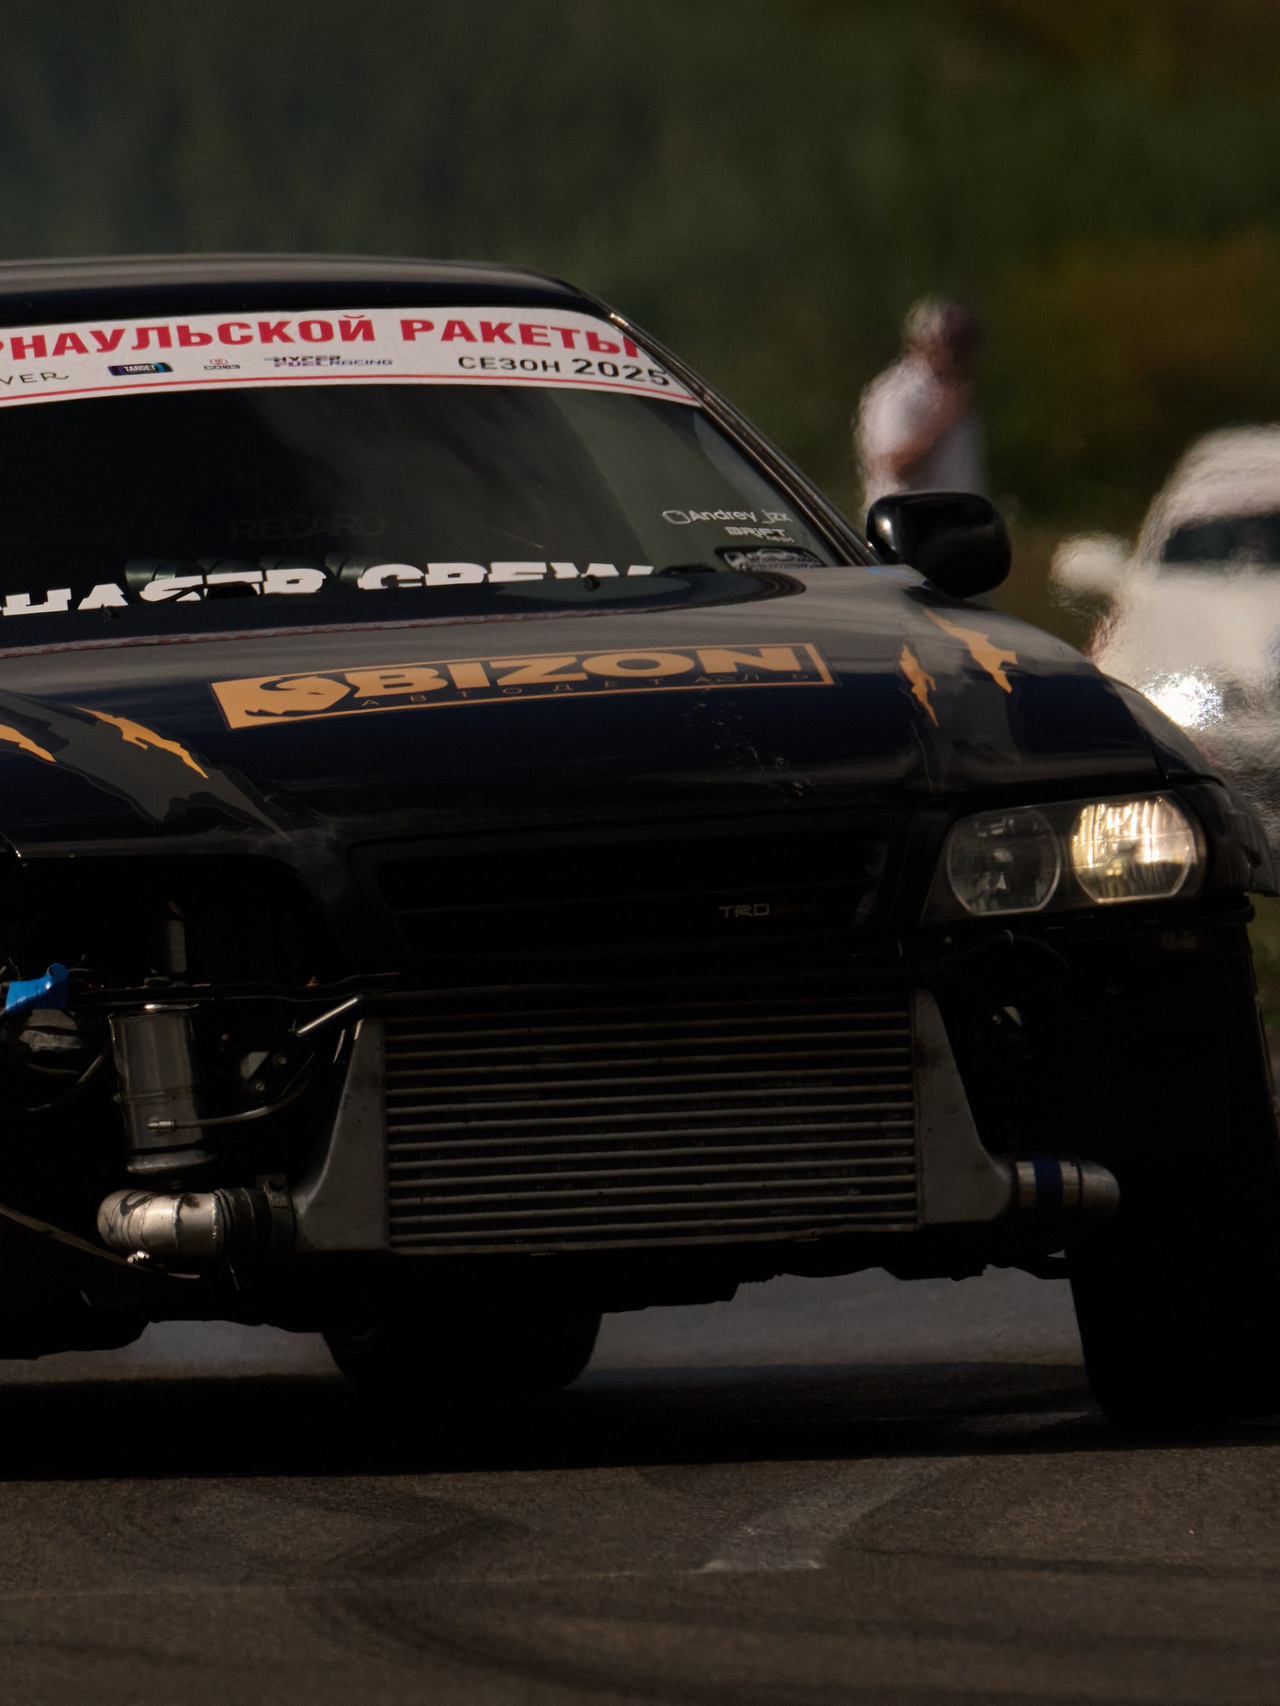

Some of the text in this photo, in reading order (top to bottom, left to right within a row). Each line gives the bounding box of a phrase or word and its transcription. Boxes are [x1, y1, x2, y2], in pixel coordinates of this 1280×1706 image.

[399, 319, 639, 358] РАКЕТЫ
[123, 364, 156, 372] TARGET
[457, 355, 670, 387] СЕЗОН 2025
[229, 512, 387, 542] RECARO
[344, 647, 803, 699] BIZON
[718, 903, 770, 918] TRD
